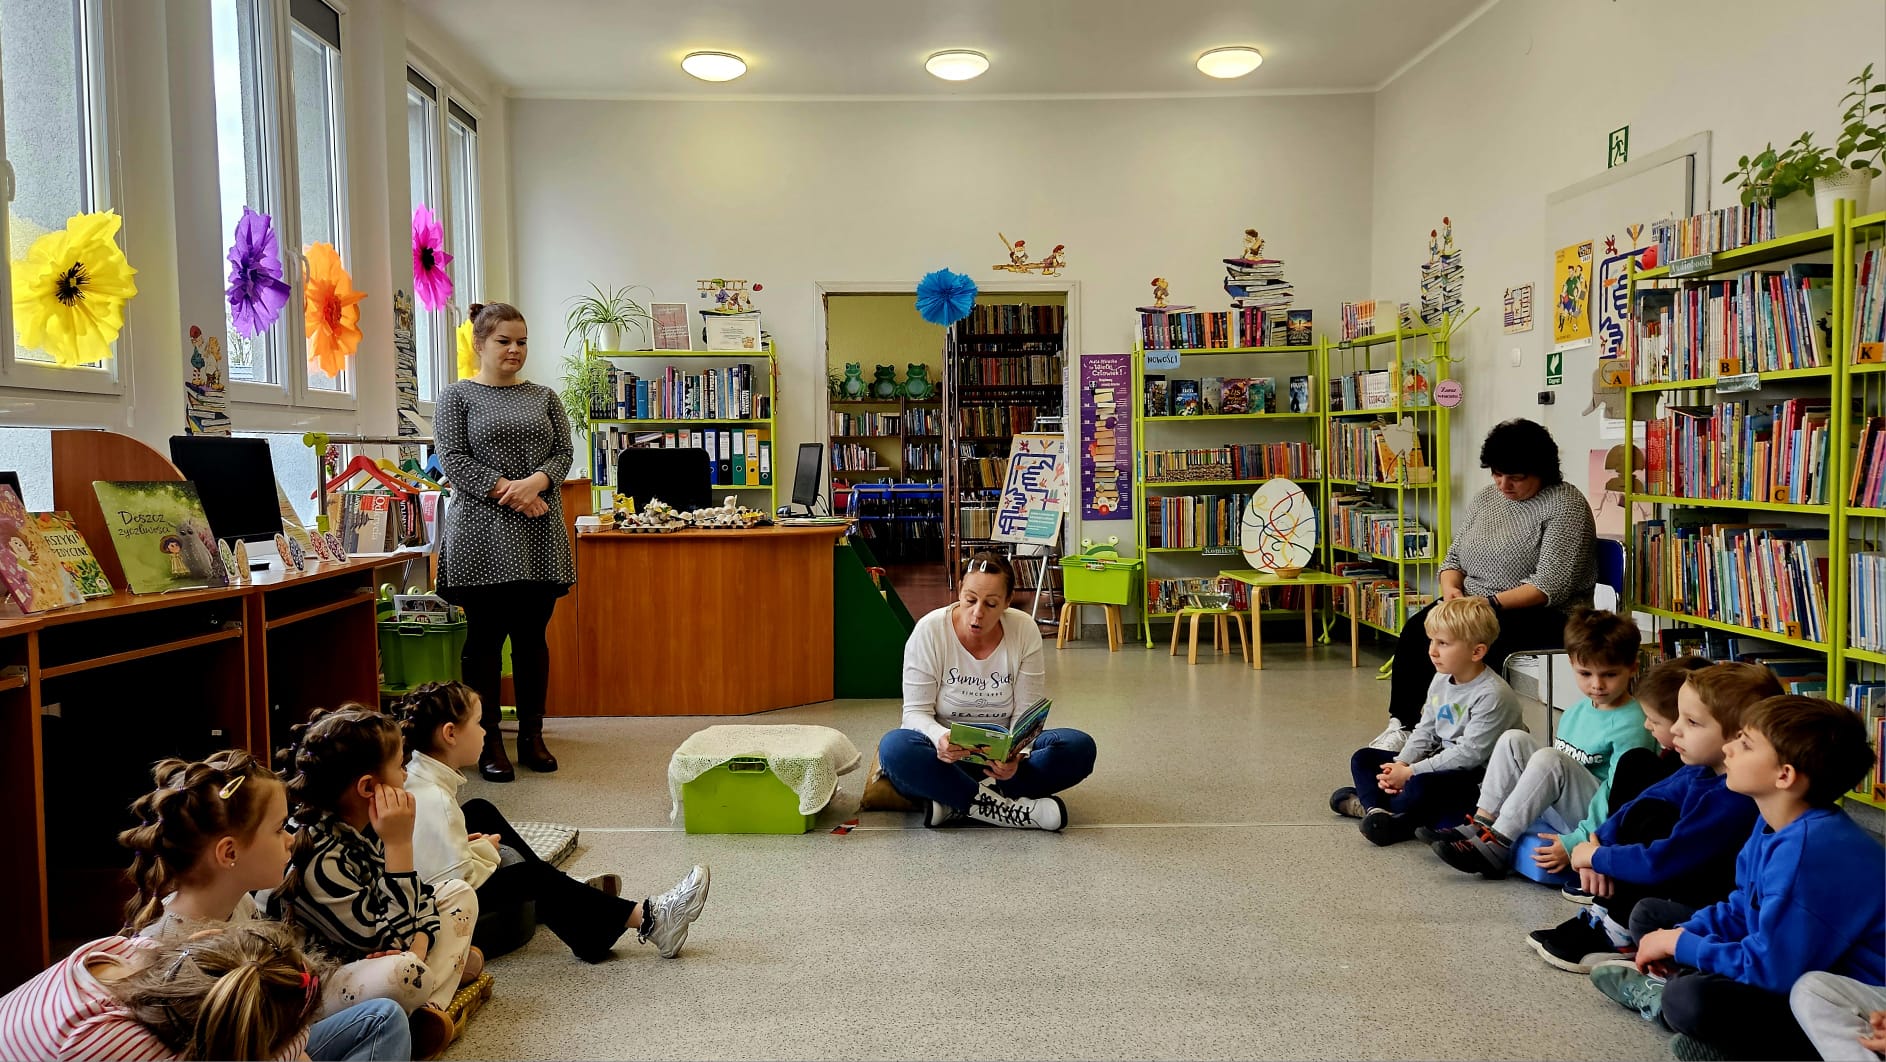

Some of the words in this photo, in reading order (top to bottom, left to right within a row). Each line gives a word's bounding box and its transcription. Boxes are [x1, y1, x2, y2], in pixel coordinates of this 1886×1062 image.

[1147, 353, 1178, 364] NOWOŚCI
[1861, 346, 1873, 360] K
[1721, 362, 1730, 373] B
[1613, 374, 1622, 385] A
[1775, 489, 1785, 502] C
[118, 510, 166, 525] Deszcz
[1675, 601, 1684, 612] D
[1788, 625, 1797, 637] F
[947, 667, 986, 690] Sunny
